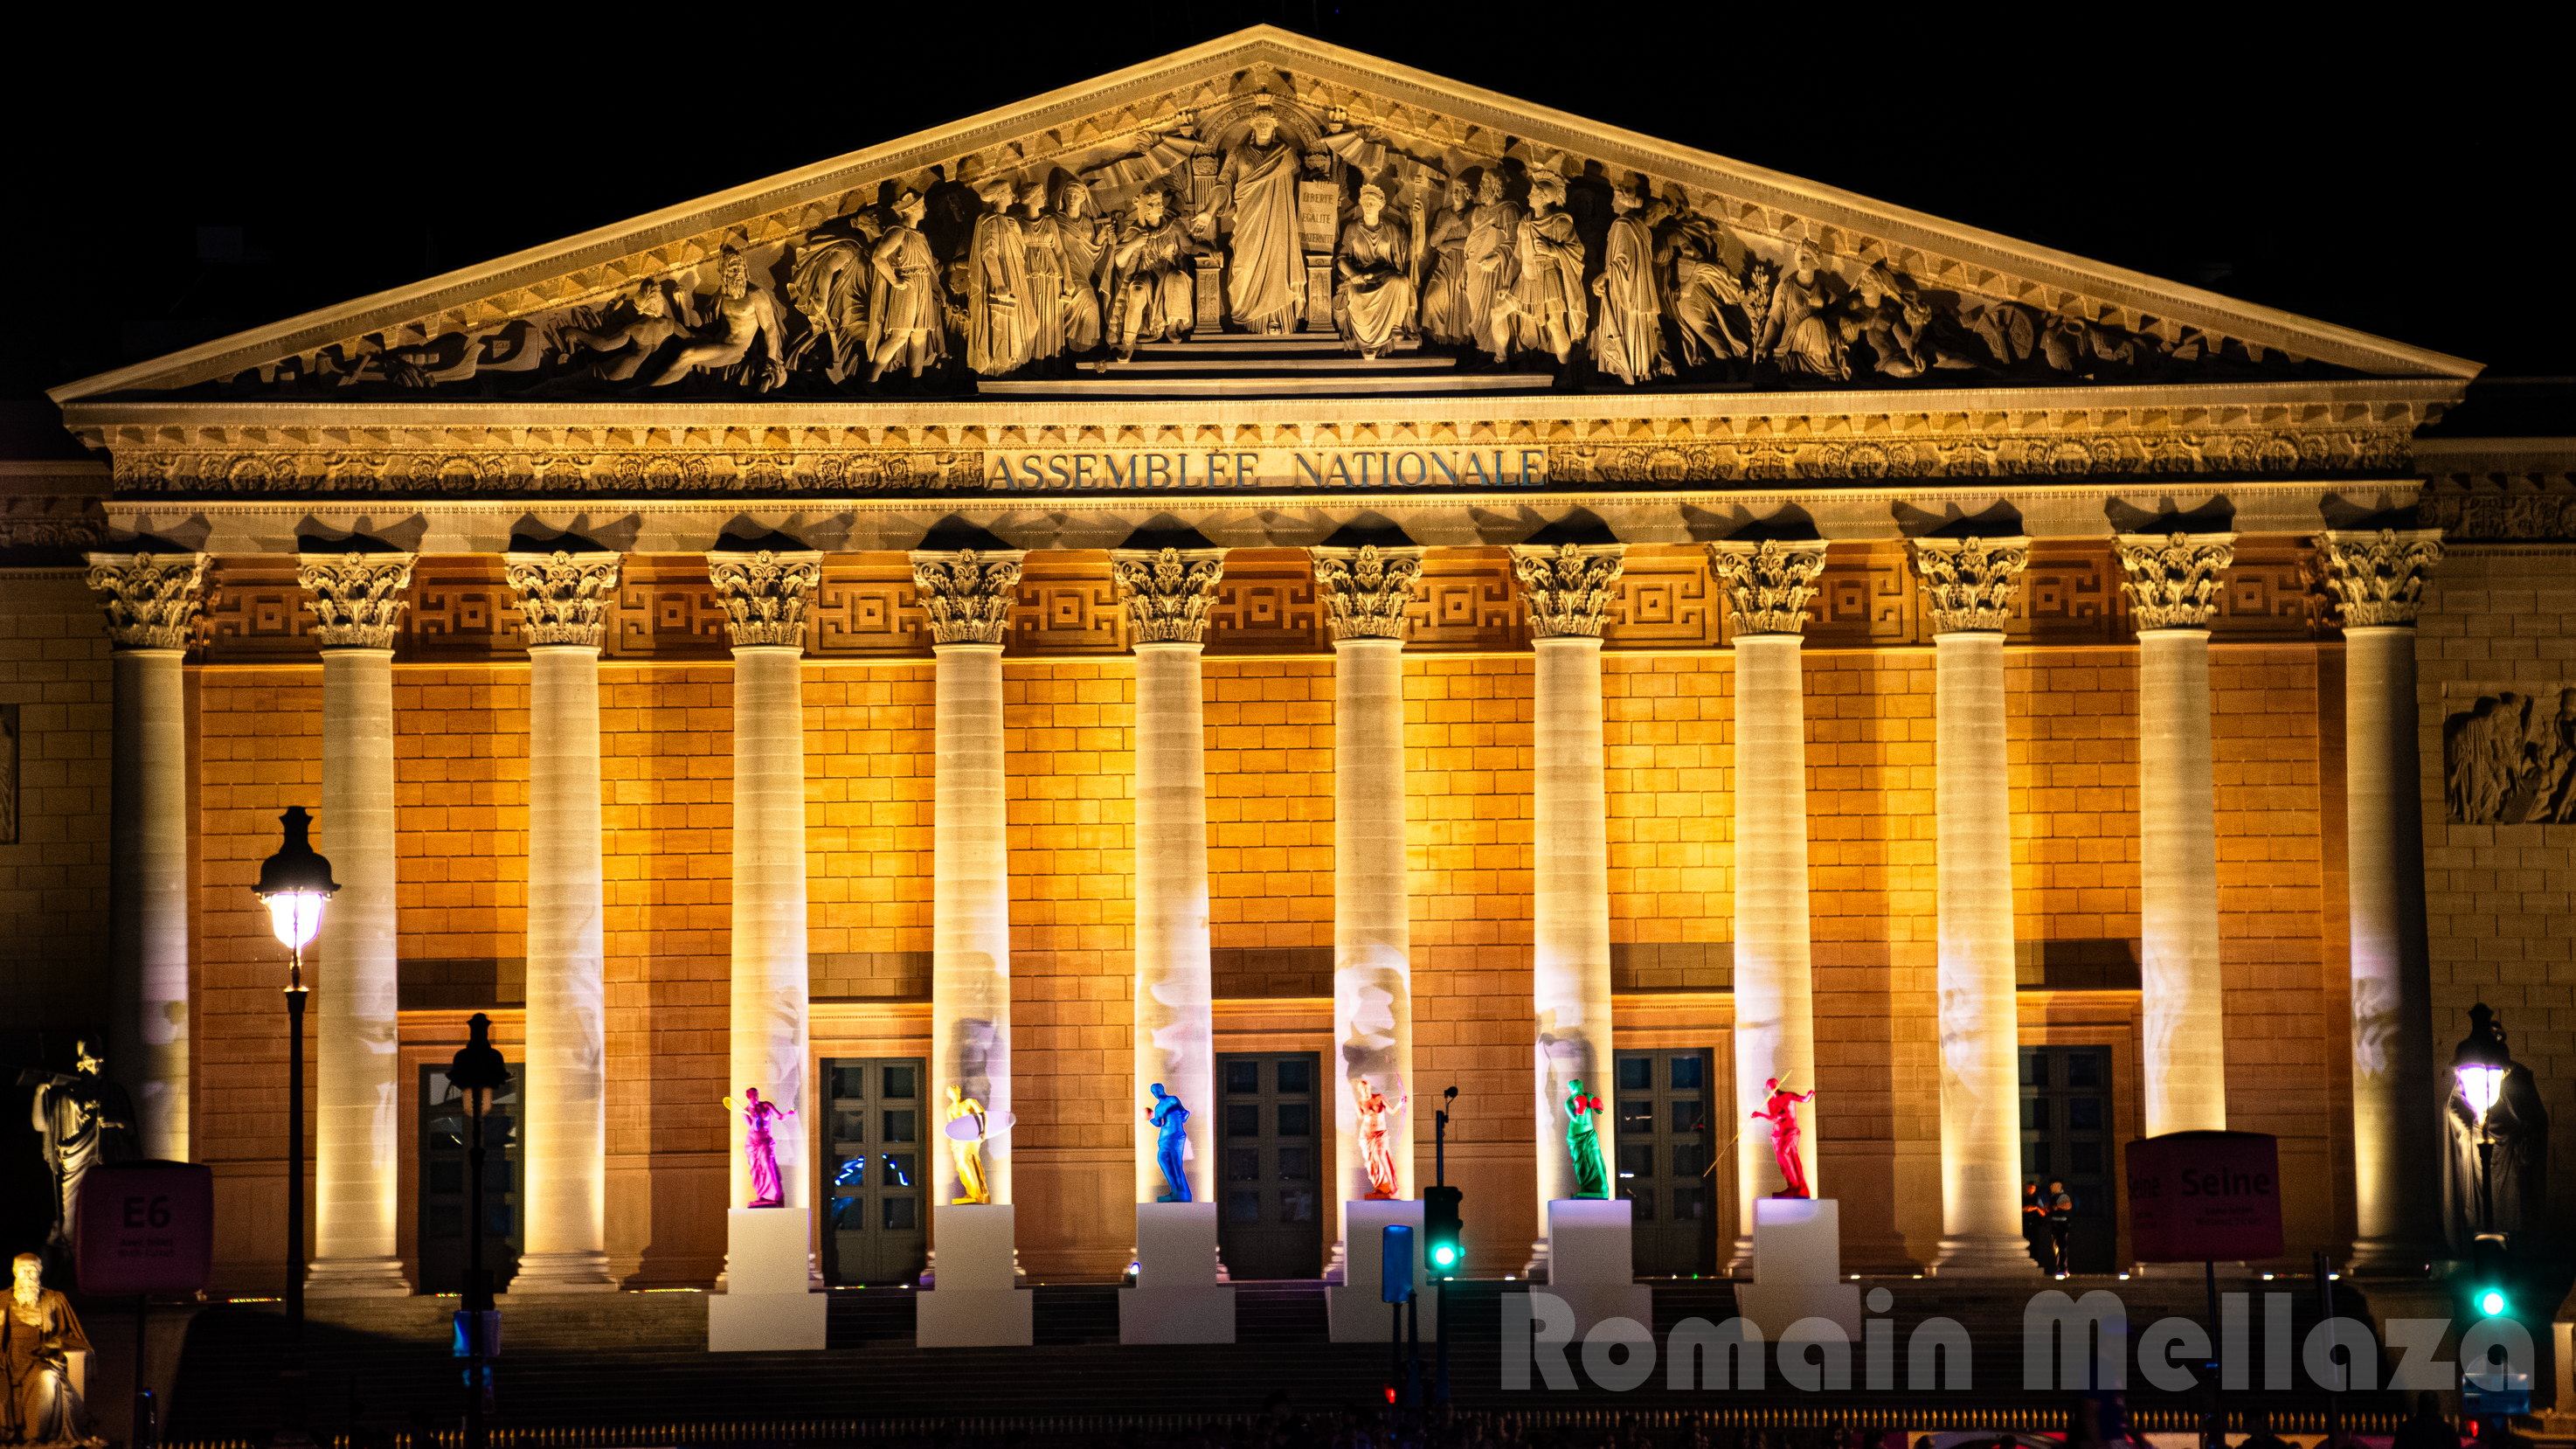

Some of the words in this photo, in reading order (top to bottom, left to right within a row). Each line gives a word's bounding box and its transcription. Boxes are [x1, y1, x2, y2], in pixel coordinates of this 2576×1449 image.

[986, 448, 1261, 490] ASSEMBLÉE
[1293, 450, 1547, 489] NATIONALE
[2182, 1167, 2271, 1196] Seine
[124, 1196, 170, 1229] E6
